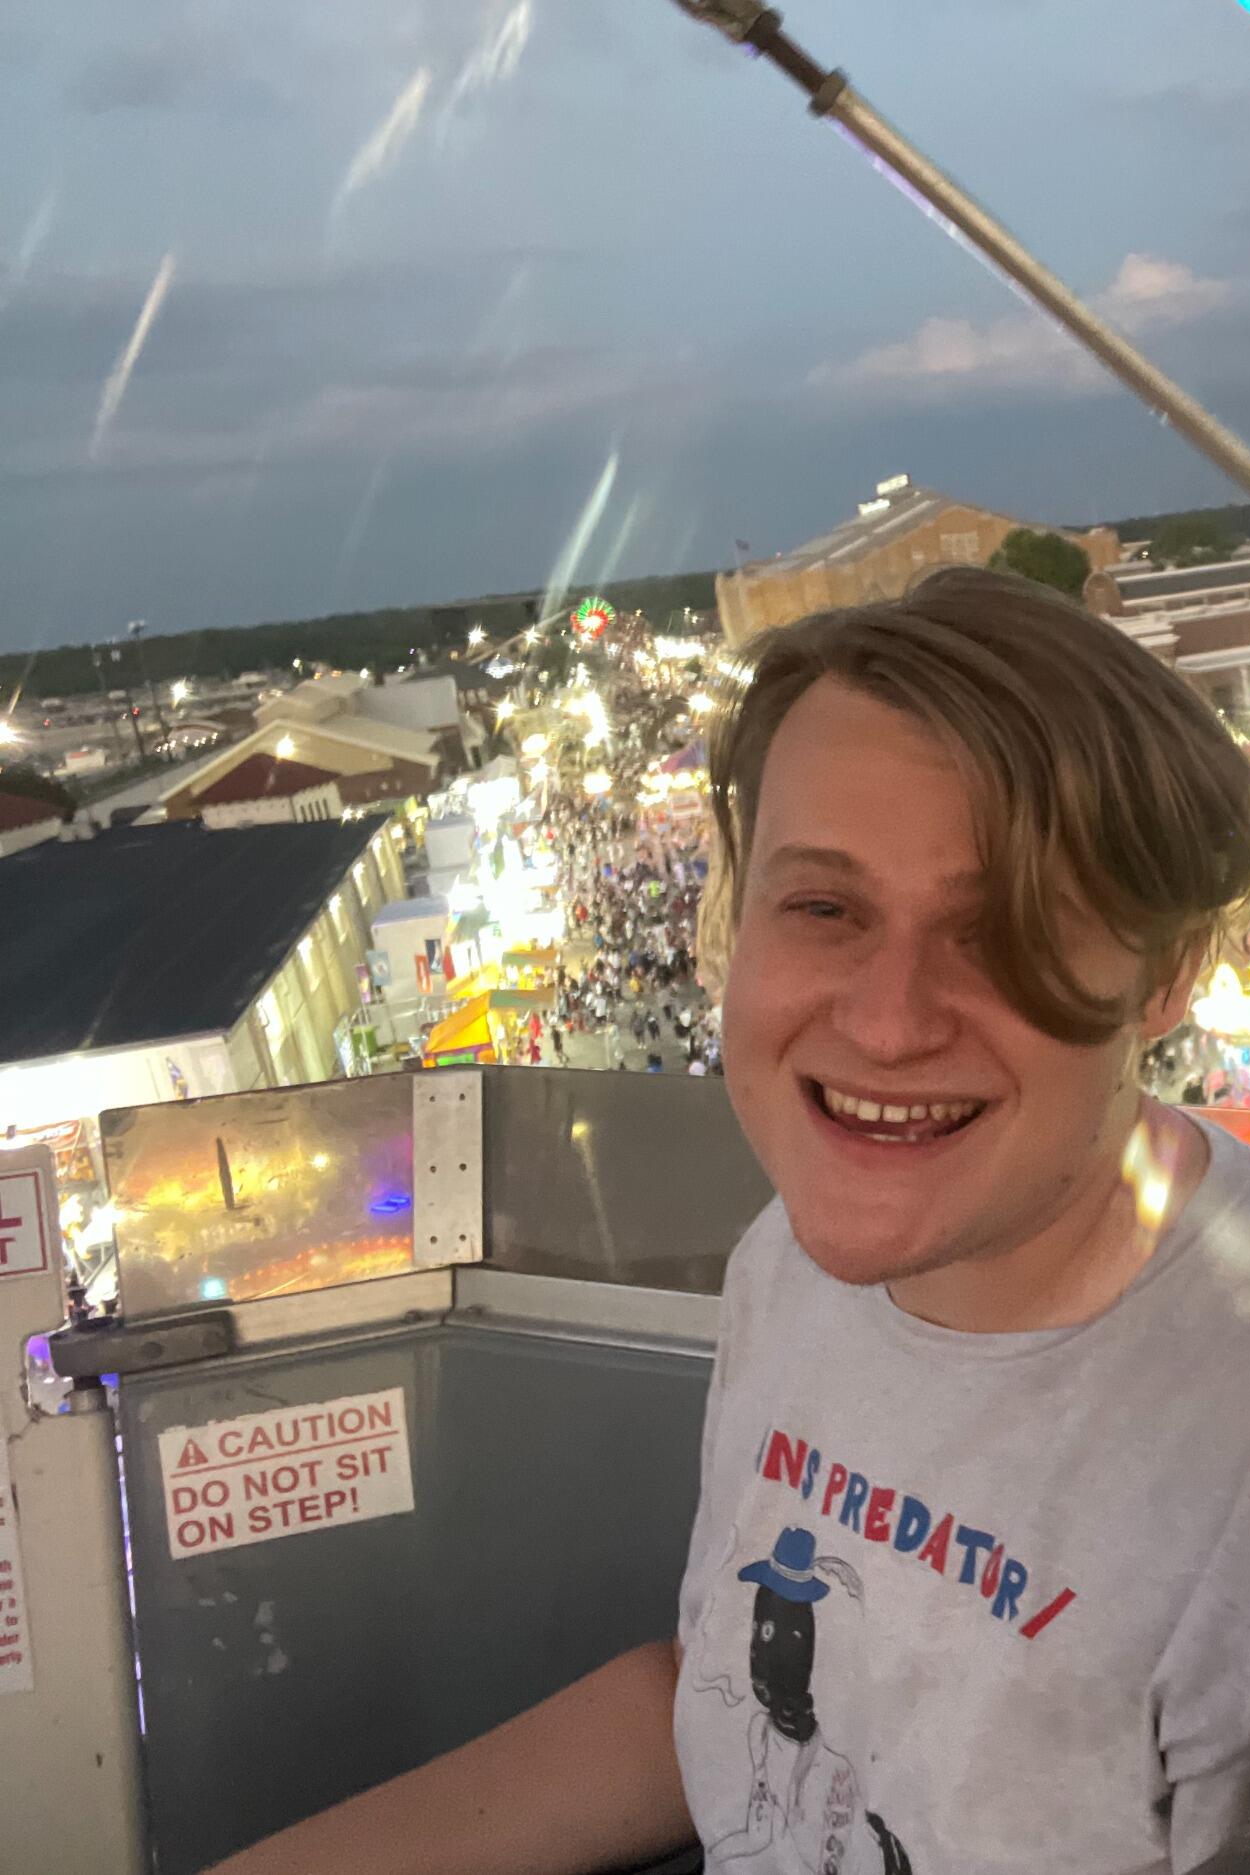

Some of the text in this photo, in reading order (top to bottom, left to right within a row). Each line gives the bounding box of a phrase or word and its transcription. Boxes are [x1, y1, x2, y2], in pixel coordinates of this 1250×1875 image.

[218, 1401, 393, 1458] CAUTION
[172, 1446, 392, 1515] DO NOT SIT
[176, 1487, 359, 1548] ON STEP!
[821, 1461, 1028, 1621] PREDATOR
